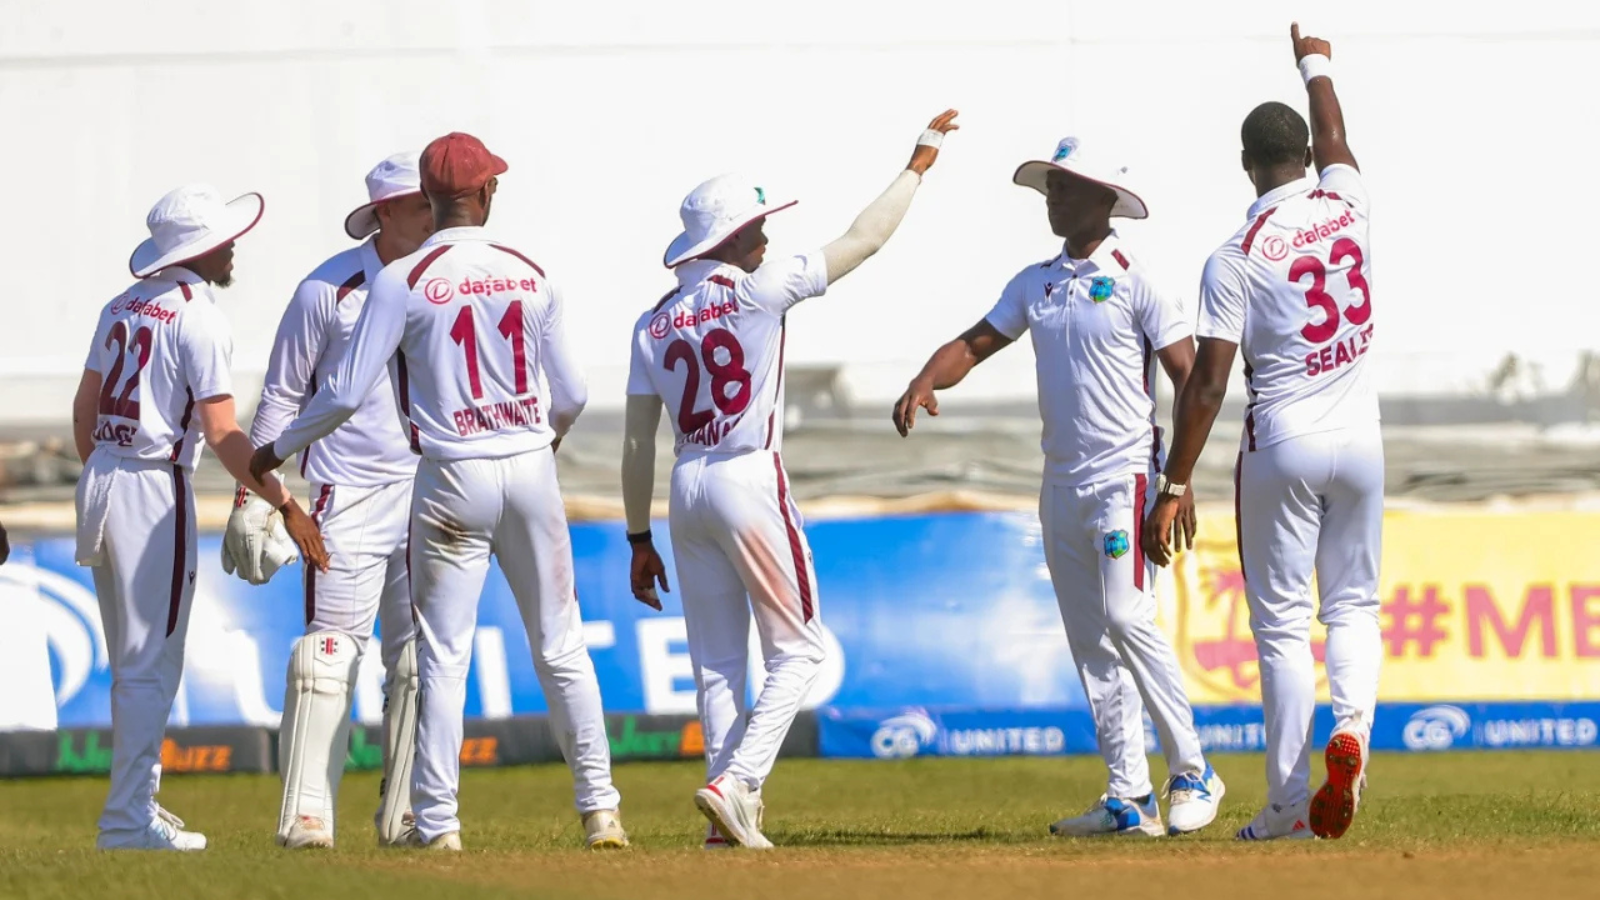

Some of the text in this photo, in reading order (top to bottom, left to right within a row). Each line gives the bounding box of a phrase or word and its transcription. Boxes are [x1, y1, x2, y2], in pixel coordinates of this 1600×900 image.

[1291, 209, 1355, 248] dafabet
[459, 274, 537, 297] dafabet
[1288, 237, 1371, 343] 33
[126, 297, 177, 325] dafabet
[673, 298, 739, 329] dafabet
[449, 300, 528, 399] 11
[99, 321, 153, 420] 22
[663, 328, 751, 434] 28
[453, 396, 541, 437] BRATHWAITE
[953, 726, 1065, 754] UNITED
[1485, 717, 1598, 747] UNITED
